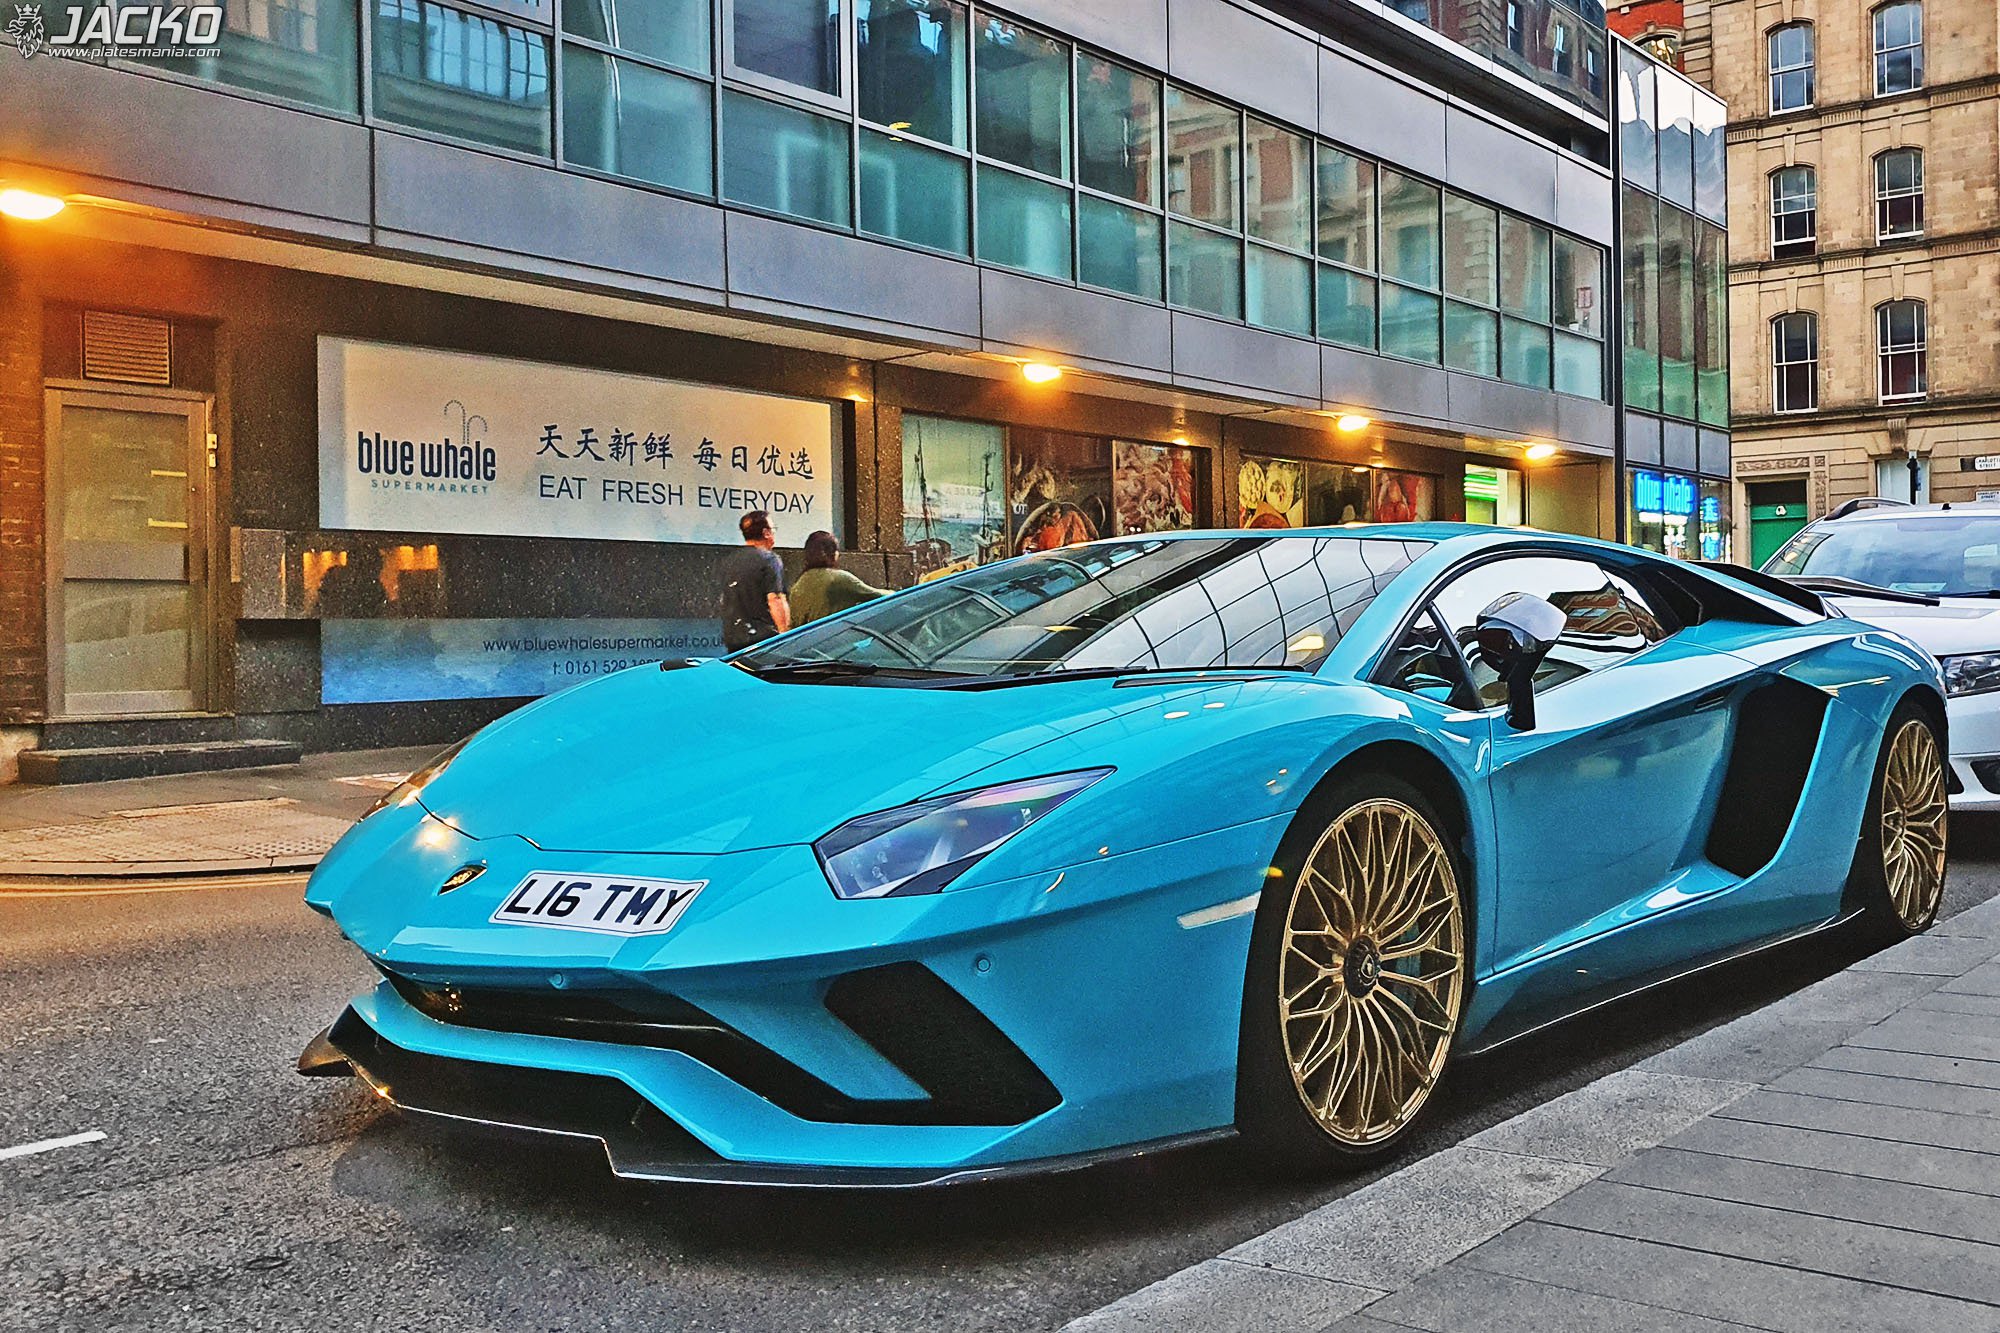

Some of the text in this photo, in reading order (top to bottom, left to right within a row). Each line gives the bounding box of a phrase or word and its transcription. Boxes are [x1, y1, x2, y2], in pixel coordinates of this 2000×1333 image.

[358, 431, 496, 482] blue whale
[536, 424, 815, 480] 天天新鲜 每日优选
[371, 479, 490, 494] SUPERMARKET
[539, 474, 815, 514] EAT FRESH EVERYDAY
[1636, 472, 1662, 510] blue
[483, 634, 724, 652] www.bluewhalesupermarket.co.u
[552, 661, 561, 675] t:
[565, 660, 597, 675] 0161
[602, 659, 627, 674] 529
[503, 879, 695, 926] L16 TMY
